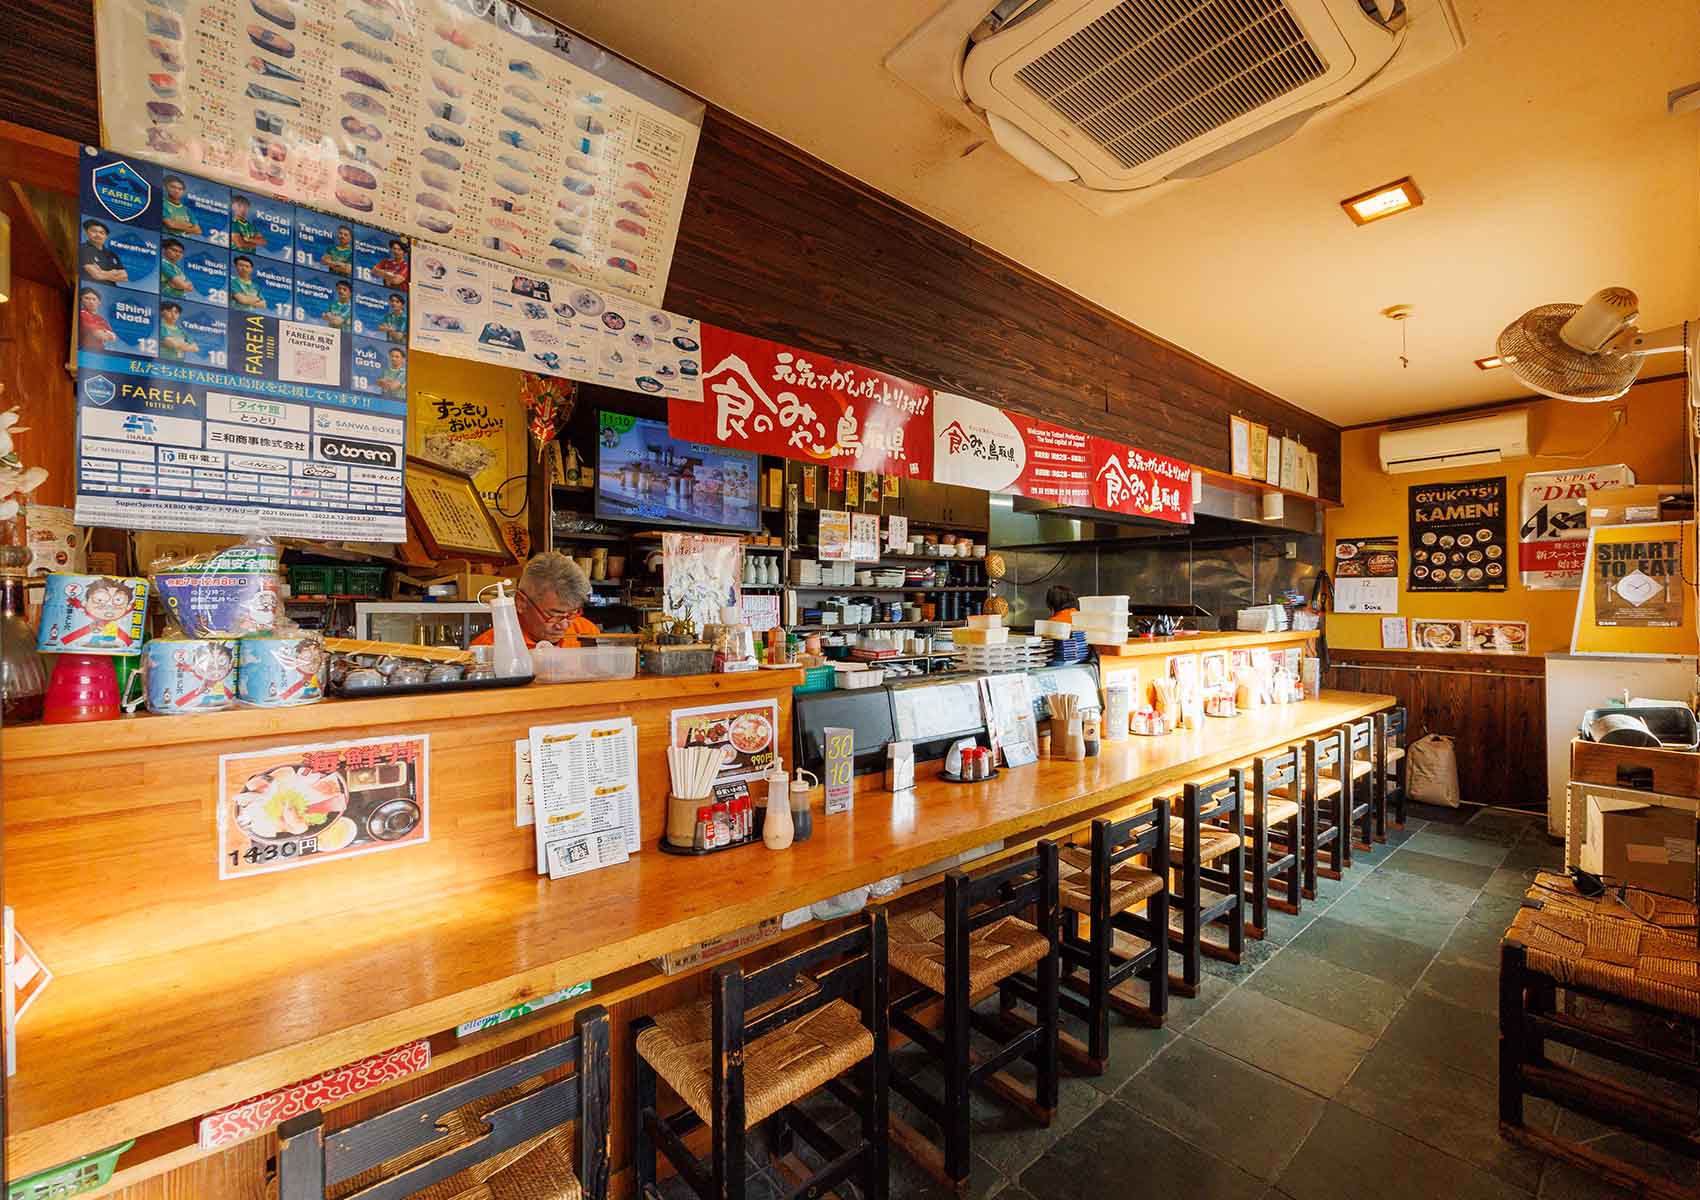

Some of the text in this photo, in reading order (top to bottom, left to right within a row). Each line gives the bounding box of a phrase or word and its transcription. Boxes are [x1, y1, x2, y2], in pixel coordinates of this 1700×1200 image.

[101, 187, 142, 204] FAREIA
[256, 209, 290, 226] Kodai
[270, 223, 290, 237] Doi
[299, 223, 333, 239] Tenchi
[299, 232, 315, 242] Ise
[296, 251, 314, 266] 91
[256, 270, 292, 285] Makoto
[296, 280, 333, 294] Mamoru
[115, 302, 152, 317] Shinji
[275, 303, 293, 318] 17
[115, 311, 150, 325] Noda
[285, 329, 315, 342] FAREIA
[137, 338, 157, 356] 12
[245, 315, 265, 376] FAREIA
[355, 349, 377, 360] Yuki
[355, 356, 382, 369] Goto
[121, 384, 197, 408] FAREIA
[237, 401, 281, 415] タイヤ館
[431, 398, 488, 420] すっきり
[240, 413, 277, 426] とっとり
[448, 417, 504, 433] おいしい!
[601, 412, 631, 427] 11:10
[210, 431, 305, 451] 三和商事株式会社
[1554, 472, 1597, 484] SUPER
[1415, 485, 1499, 503] GYUKOTSU
[1415, 501, 1499, 522] RAMEN!
[1598, 541, 1679, 560] SMART
[1598, 559, 1678, 577] TO EAT
[828, 735, 853, 760] 30
[302, 741, 417, 774] 海鮮丼
[751, 751, 773, 765] 990円
[831, 760, 850, 785] 10
[228, 837, 318, 866] 1430円
